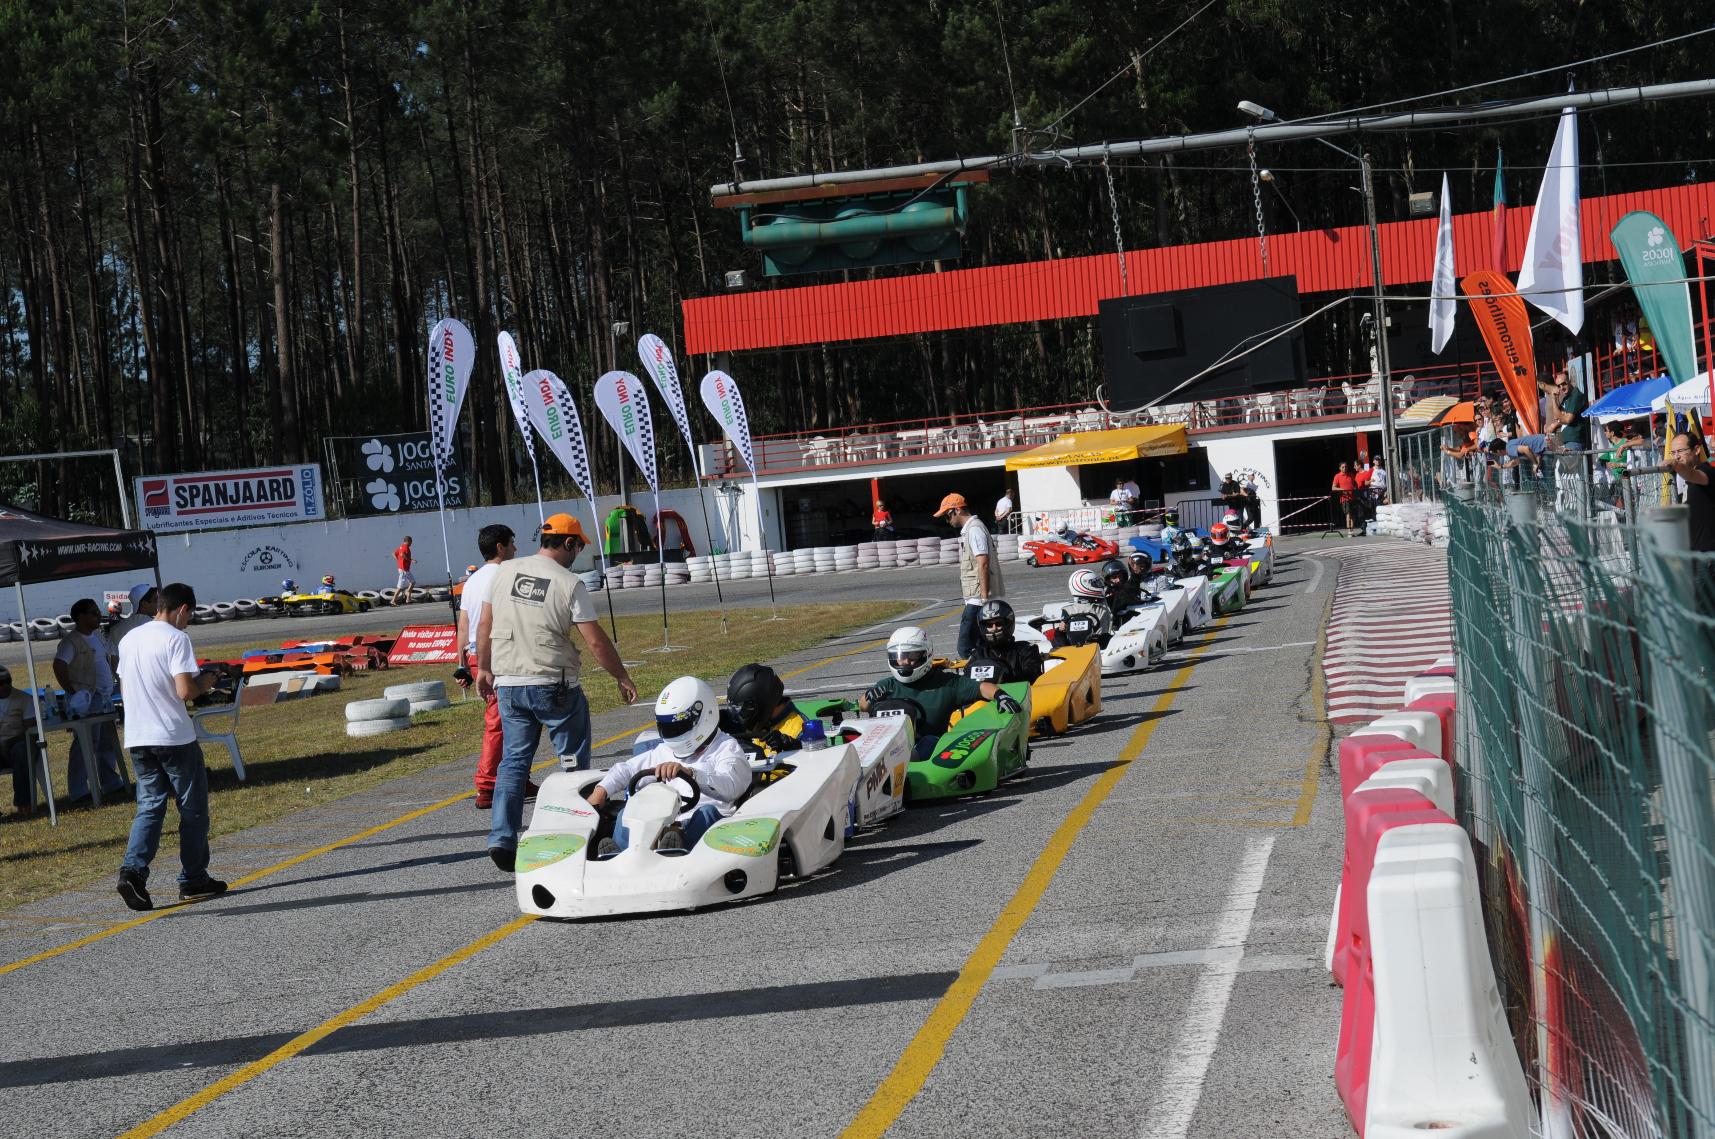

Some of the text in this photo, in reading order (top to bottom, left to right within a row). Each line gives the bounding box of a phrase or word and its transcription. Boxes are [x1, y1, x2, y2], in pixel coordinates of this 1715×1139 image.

[443, 327, 456, 405] EURO INDY
[398, 441, 455, 467] JOG
[174, 477, 296, 509] SPANJAARD
[403, 477, 461, 505] JOGOS
[146, 520, 194, 530] Lubrificantes
[195, 516, 230, 526] Especiais
[236, 513, 266, 522] Aditivos
[241, 545, 294, 572] ESCOLA KARTING
